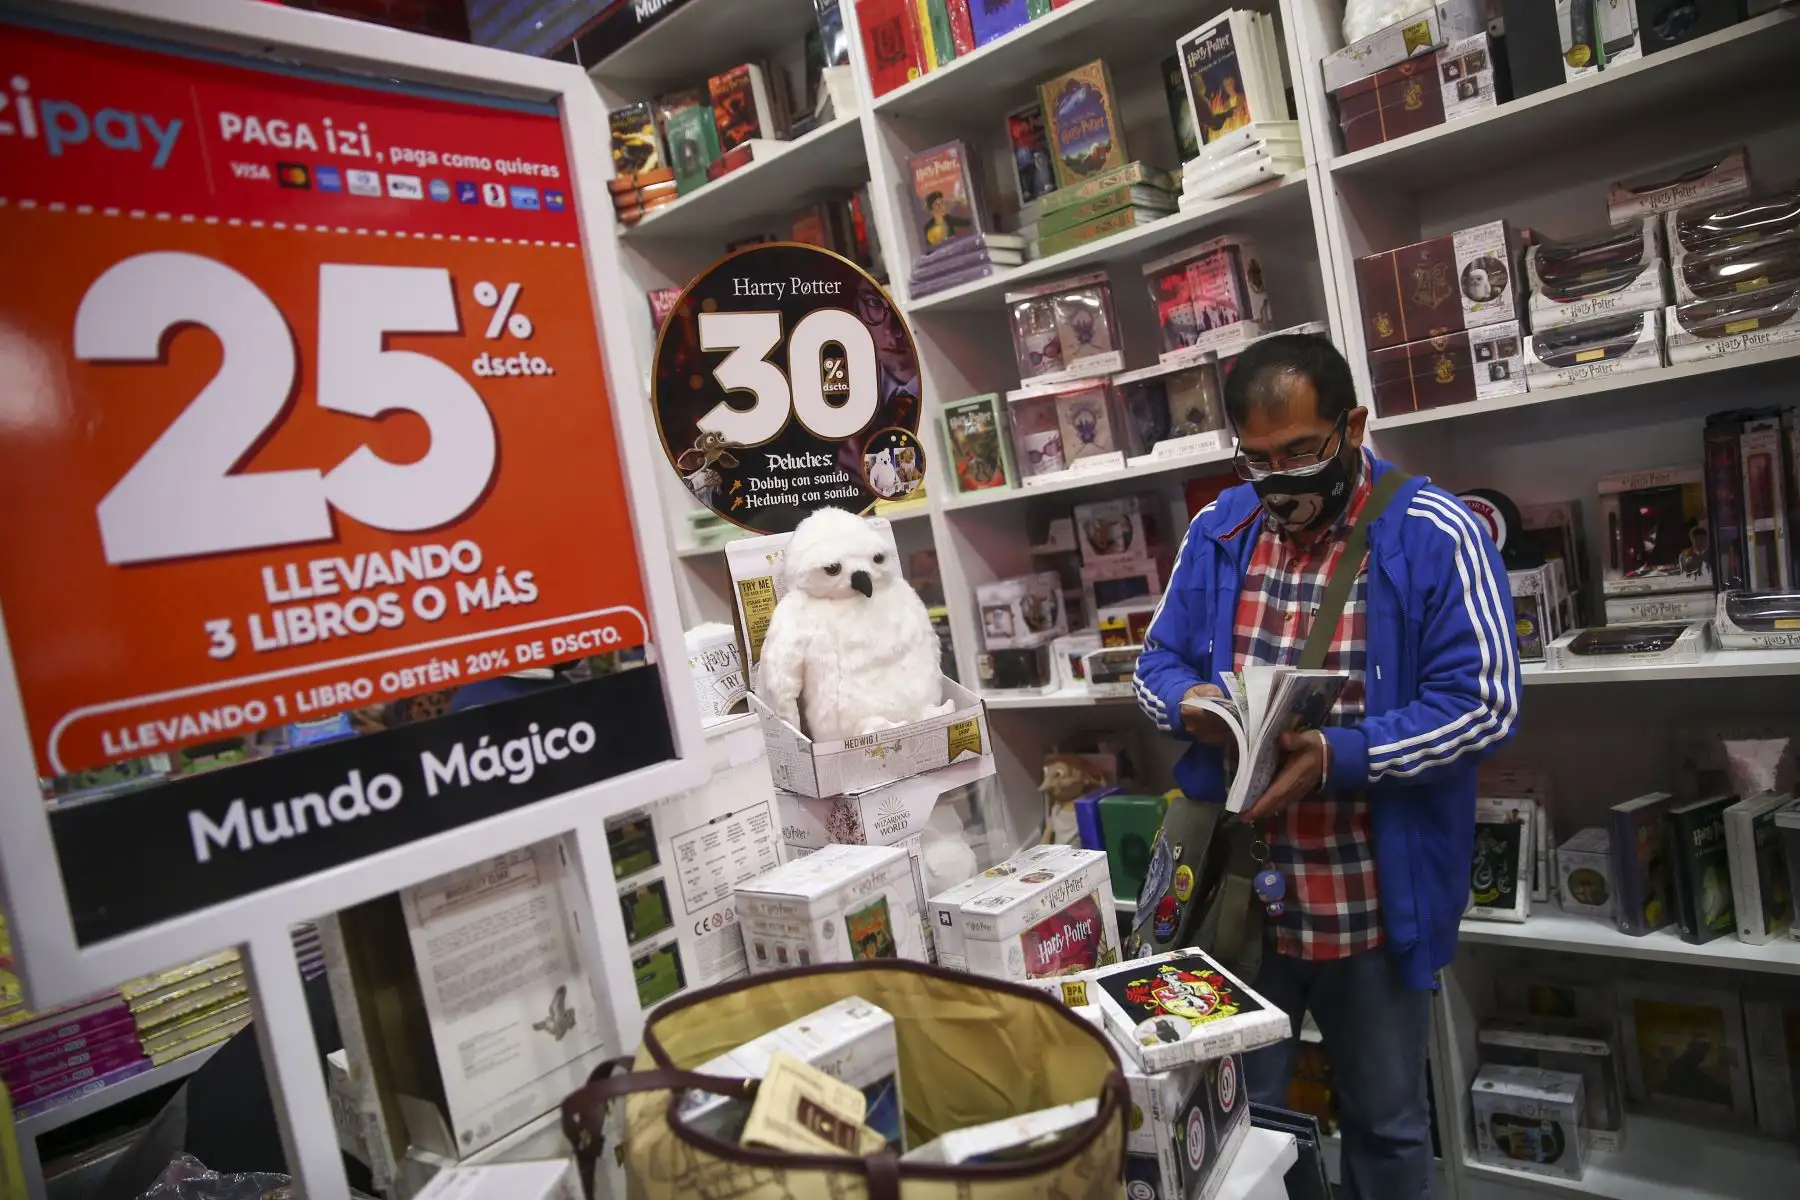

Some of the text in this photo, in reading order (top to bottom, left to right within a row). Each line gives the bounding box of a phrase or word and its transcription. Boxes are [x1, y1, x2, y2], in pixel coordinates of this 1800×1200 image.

[1187, 46, 1207, 69] Harry
[1206, 34, 1230, 60] Potter
[219, 111, 319, 152] PAGA
[390, 147, 438, 168] paga
[441, 153, 492, 172] como
[495, 158, 561, 178] quieras
[230, 161, 272, 181] VISA
[1650, 185, 1697, 208] Harry Potter
[733, 276, 842, 301] Harry Potter
[473, 281, 533, 340] %
[1570, 298, 1616, 317] Harry Potter
[1718, 333, 1770, 353] Harry Potter
[472, 353, 555, 377] dscto.
[825, 359, 844, 380] %
[1568, 363, 1613, 381] Harry Potter
[697, 309, 879, 448] 30
[823, 382, 850, 391] dscto.
[74, 251, 497, 566] 25
[747, 470, 849, 492] Dobby con sonido
[745, 485, 859, 509] Hedwing con sonido
[262, 540, 482, 604] LLEVANDO
[742, 579, 770, 592] TRY ME
[205, 566, 539, 660] 3 LIBROS O MÁS
[1641, 602, 1682, 616] Harry Potter
[1763, 635, 1787, 646] Harry
[700, 649, 730, 672] Harry
[102, 626, 622, 756] LLEVANDO 1 LIBRO OBTÉN 20% DE DSCTO.
[720, 674, 740, 690] TRY
[844, 735, 874, 750] HEDWIG
[187, 721, 597, 863] Mundo Mágico
[874, 810, 911, 830] WIZARDING
[879, 820, 908, 837] WORLD
[1047, 877, 1084, 908] Harry Potter
[1038, 918, 1092, 965] Harry Potter
[1066, 985, 1083, 996] BPA
